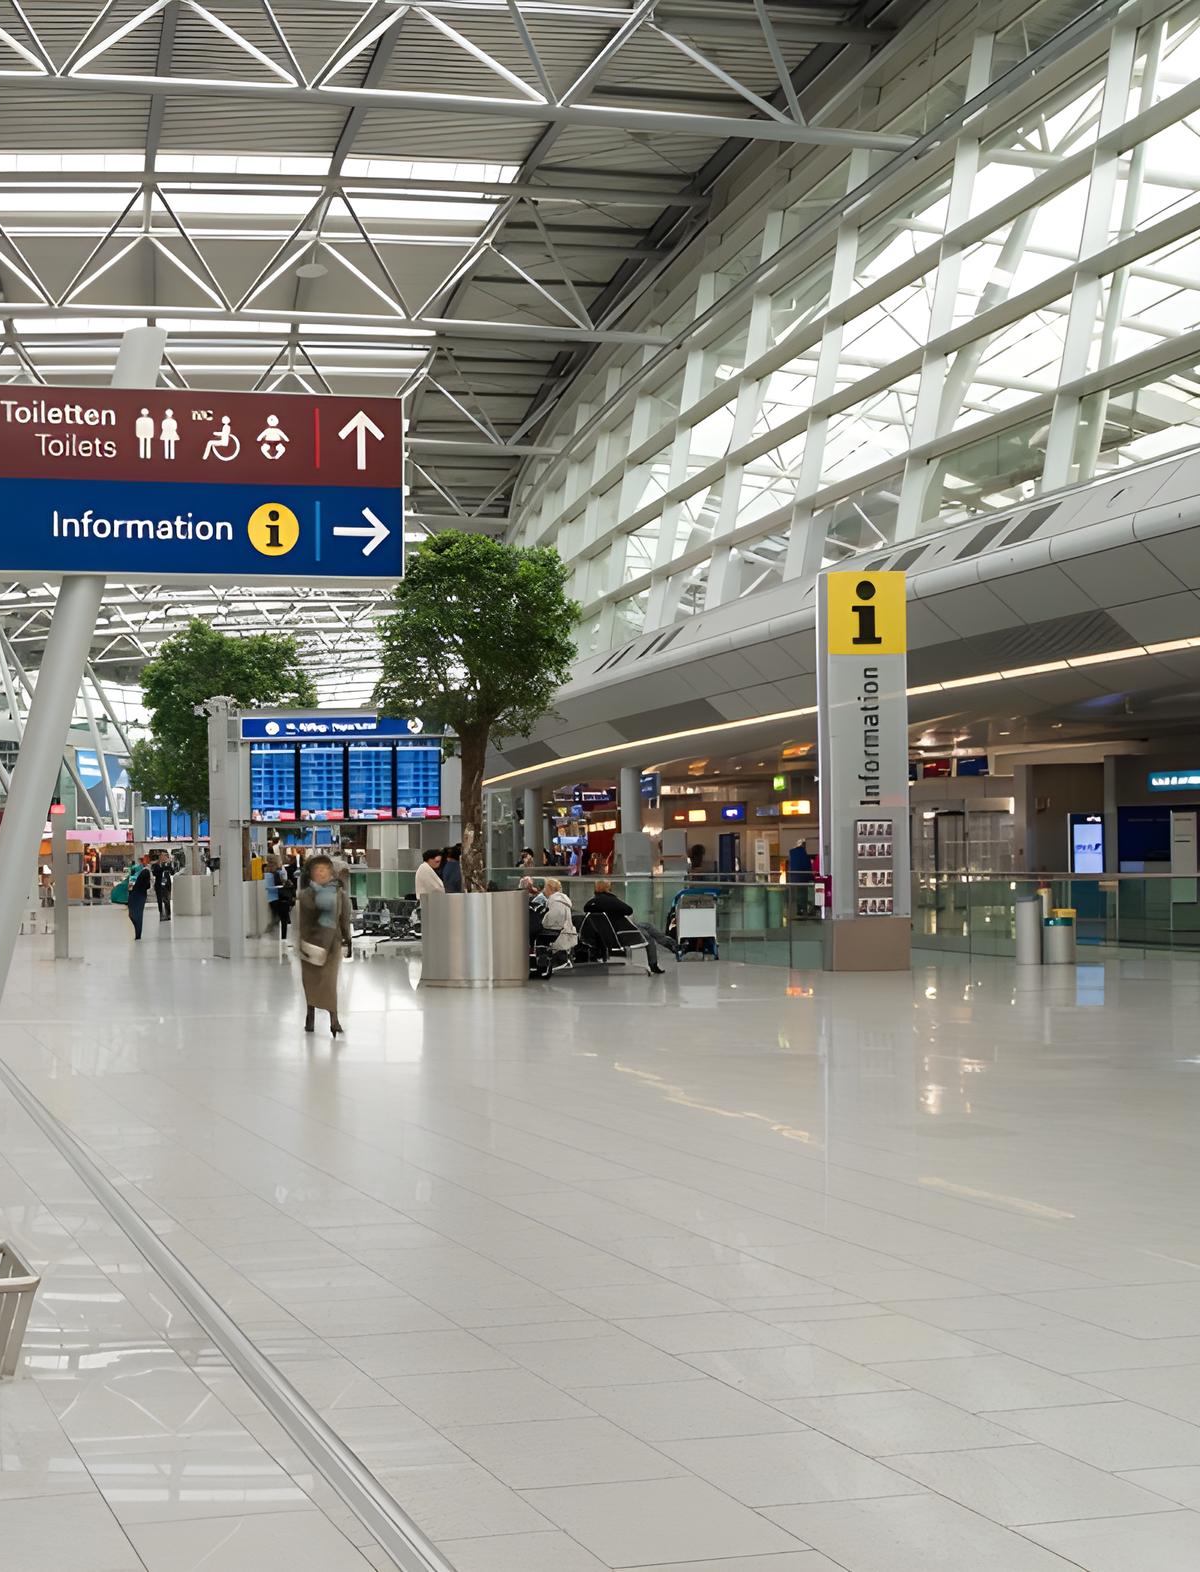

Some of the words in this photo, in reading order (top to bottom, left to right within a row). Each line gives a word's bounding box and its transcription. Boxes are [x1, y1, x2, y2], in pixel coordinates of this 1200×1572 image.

[0, 400, 116, 425] Toiletten
[35, 433, 117, 457] Toilets
[53, 510, 233, 541] Information
[857, 667, 881, 806] Information
